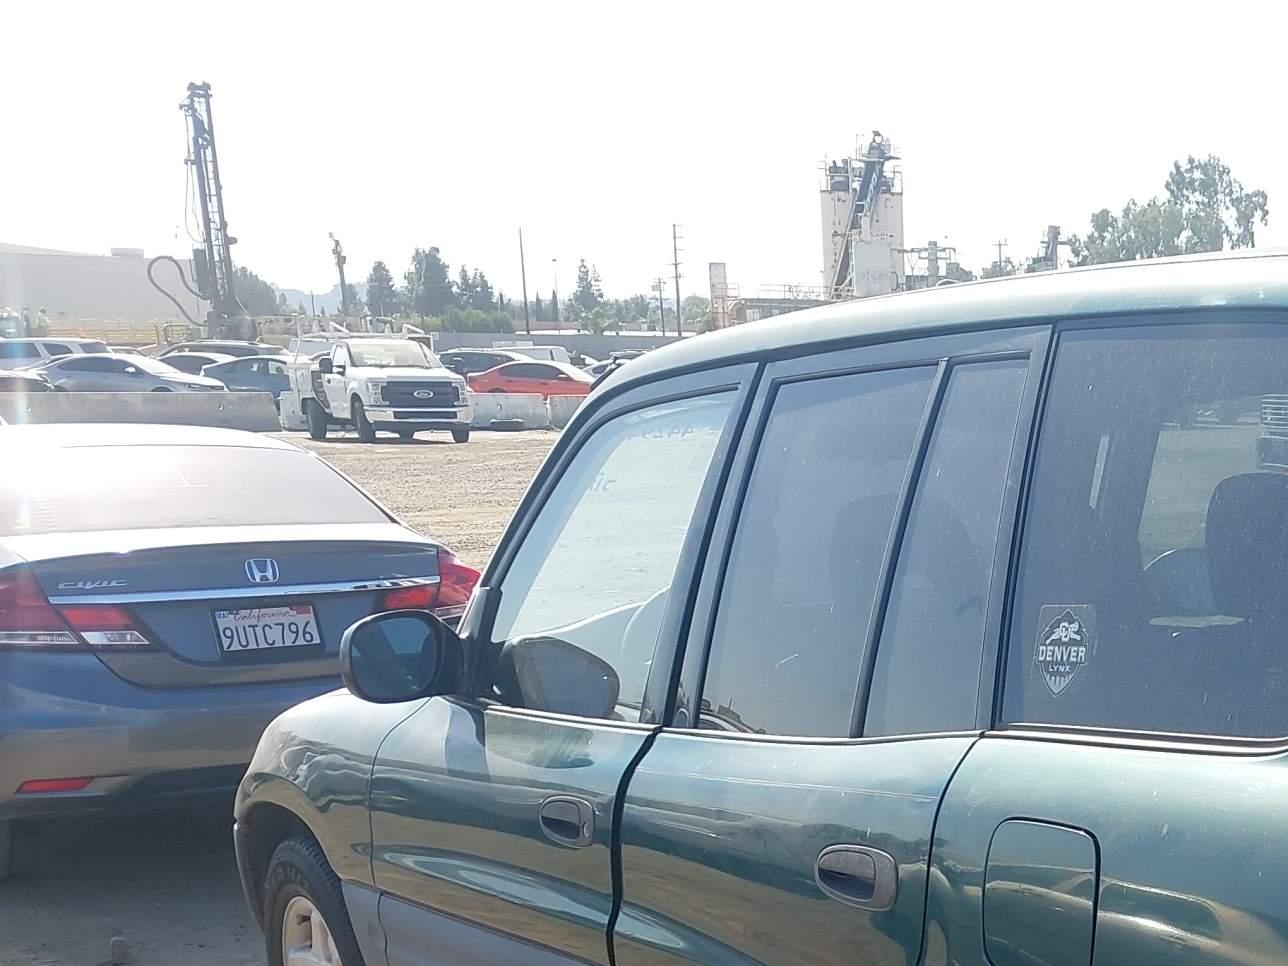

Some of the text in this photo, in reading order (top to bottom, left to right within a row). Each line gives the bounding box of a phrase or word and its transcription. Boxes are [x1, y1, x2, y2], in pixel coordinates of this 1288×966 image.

[222, 621, 314, 650] 9UTC796
[1038, 645, 1086, 662] DENVER
[1048, 664, 1071, 673] LYNX
